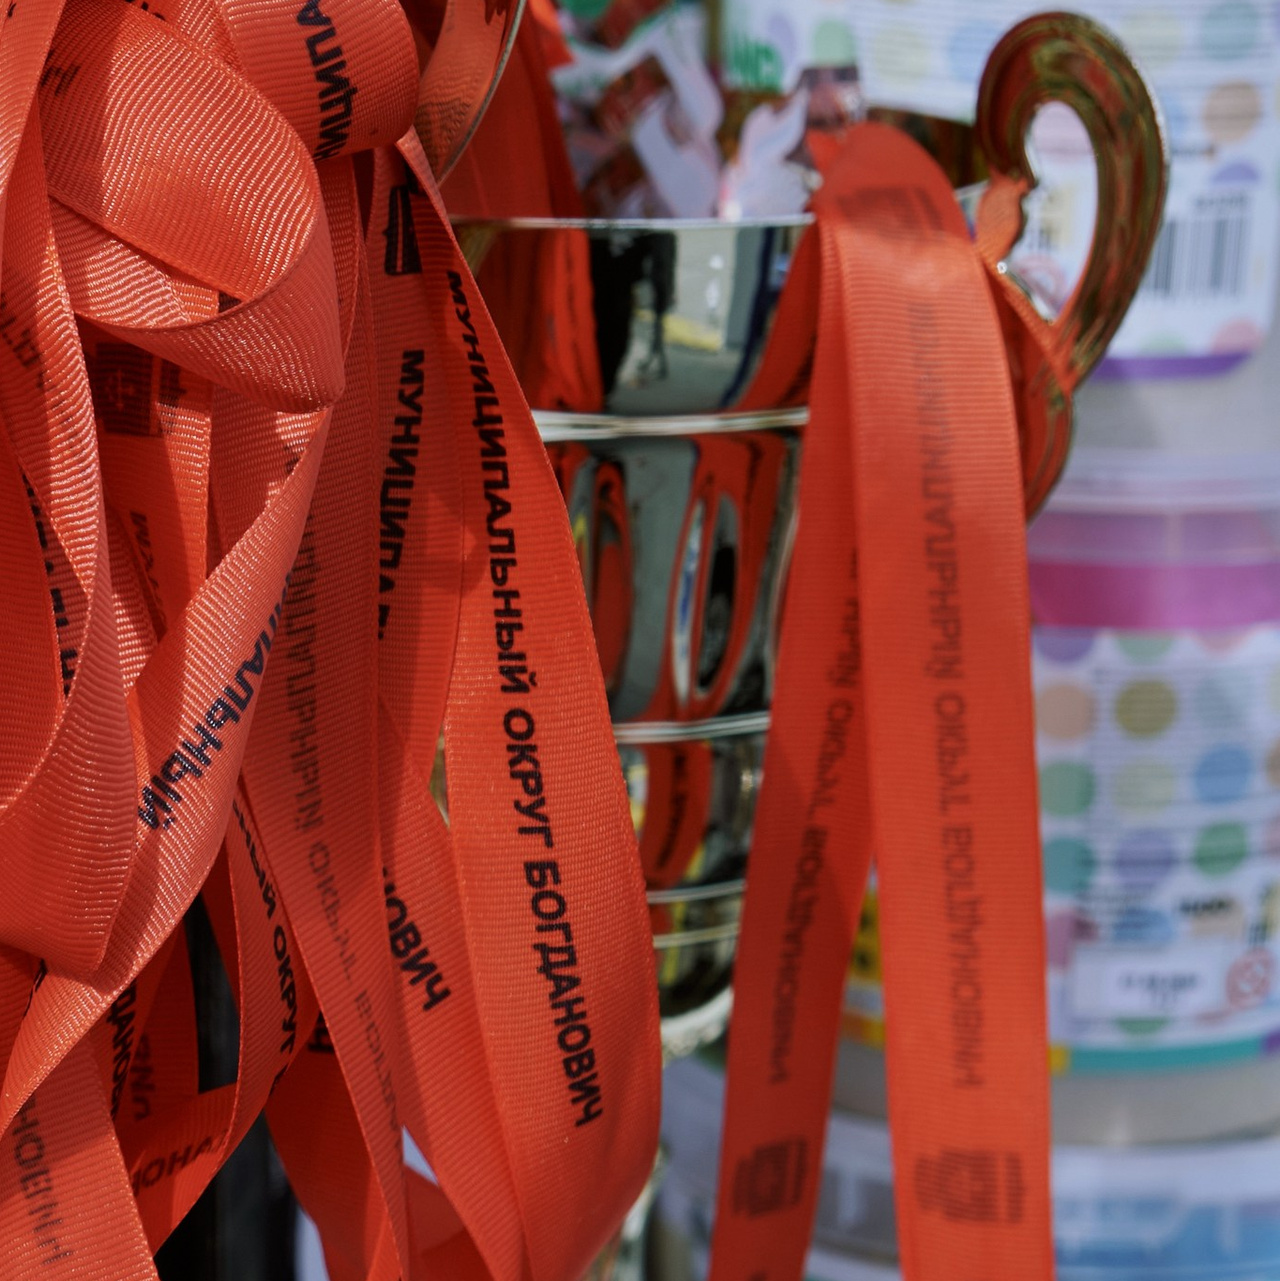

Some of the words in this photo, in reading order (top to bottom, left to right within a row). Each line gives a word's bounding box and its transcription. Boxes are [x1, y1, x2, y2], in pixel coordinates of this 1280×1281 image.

[447, 268, 540, 695] МУНИЦИПАЛЬНЫЙ
[499, 704, 554, 850] ОКРУГ
[522, 856, 604, 1128] БОГДАНОВИЧ
